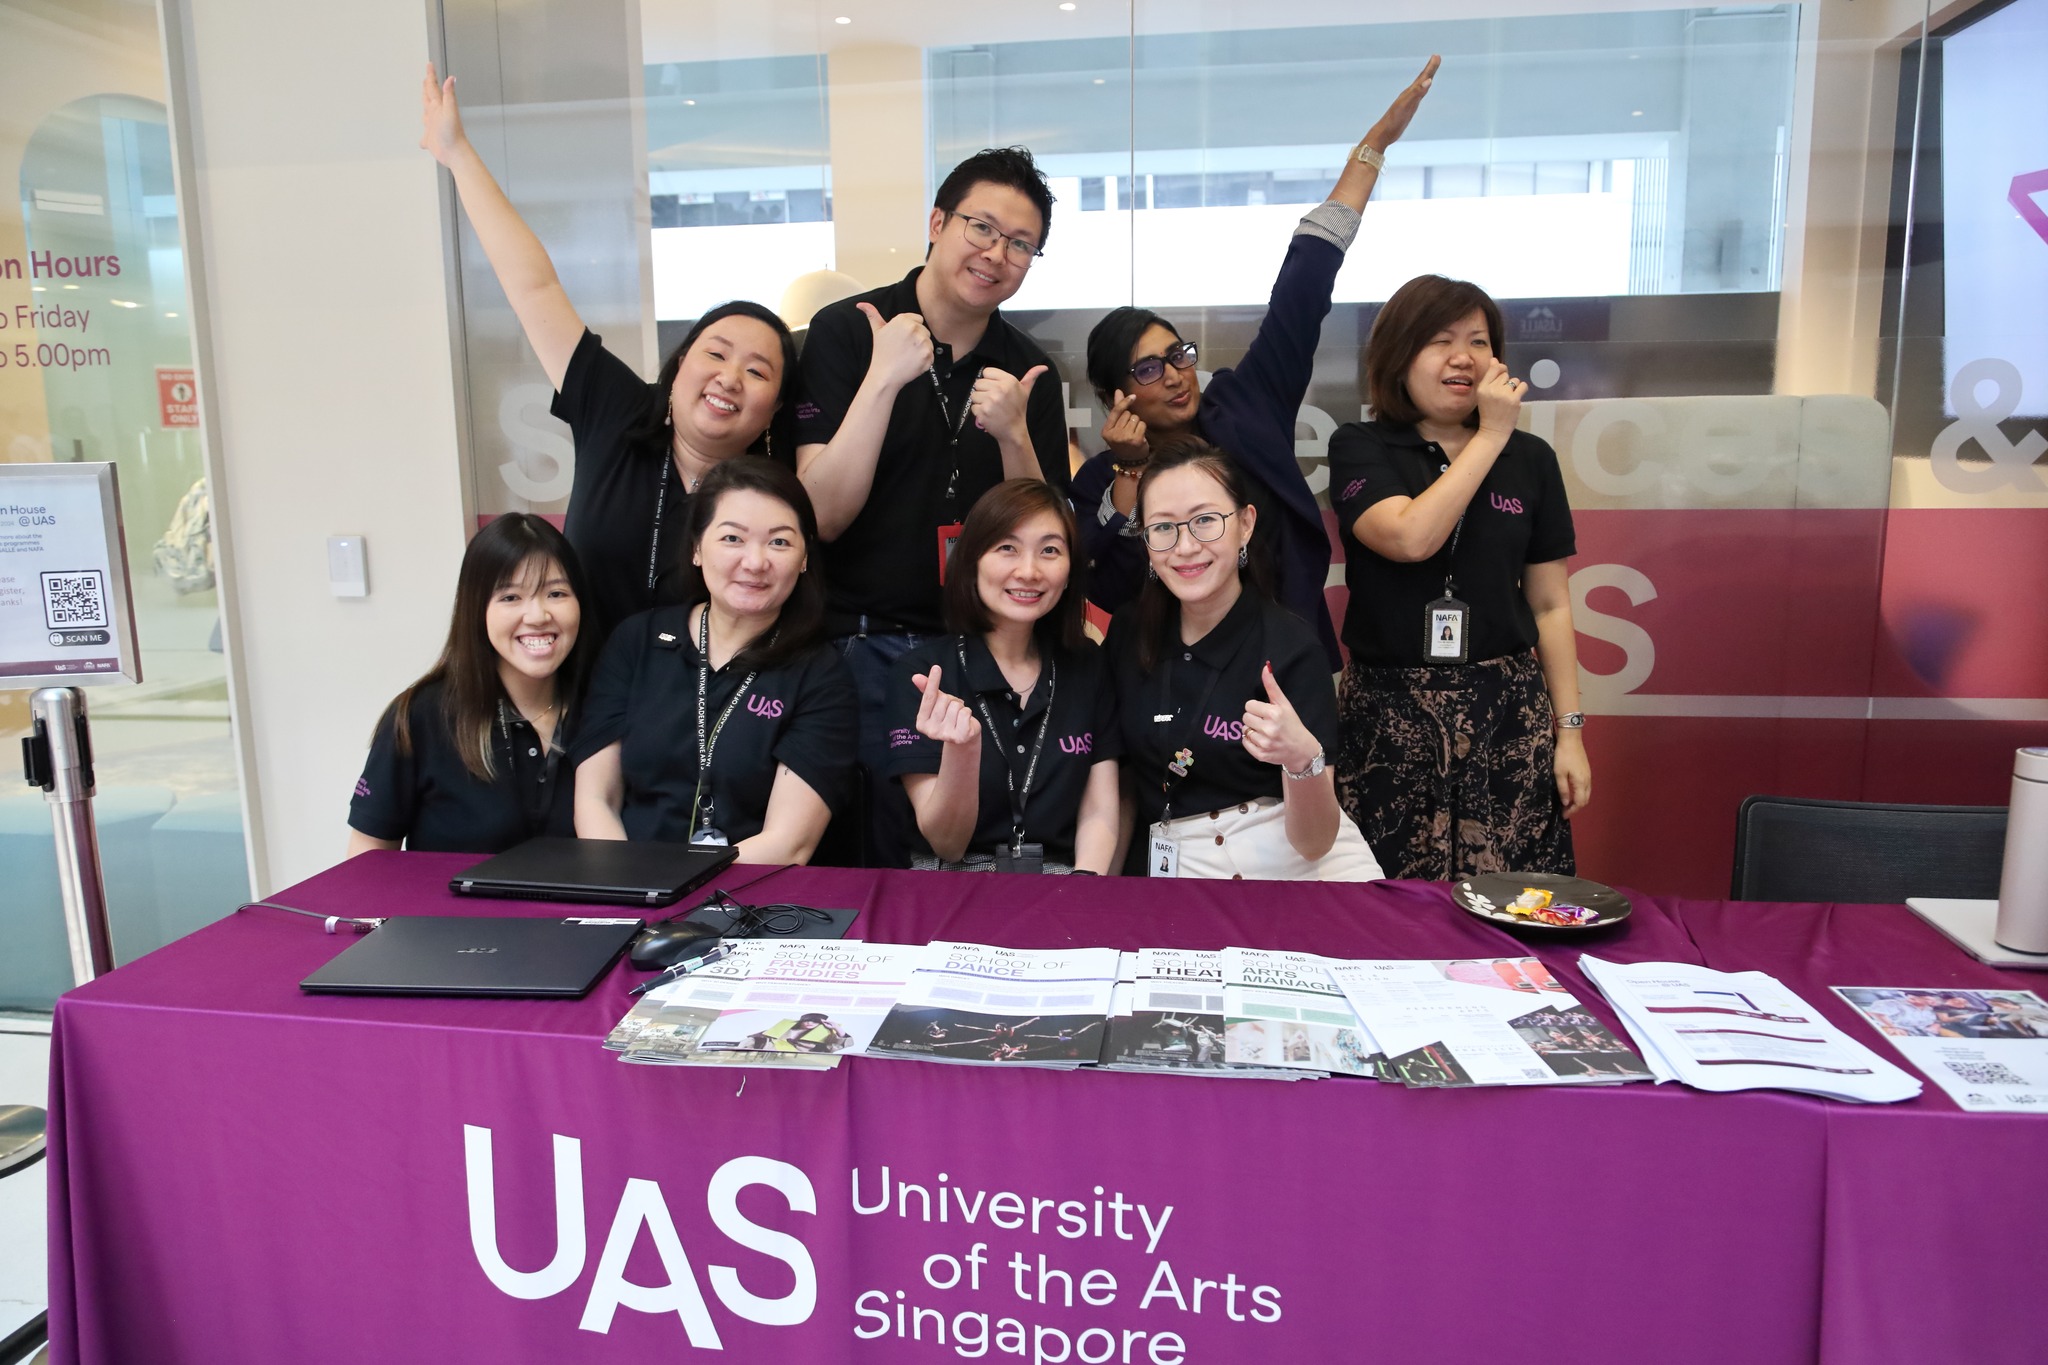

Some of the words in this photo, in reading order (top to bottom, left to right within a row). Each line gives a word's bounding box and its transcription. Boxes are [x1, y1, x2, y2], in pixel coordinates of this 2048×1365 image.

[31, 251, 121, 279] Hours
[15, 304, 90, 332] Friday
[15, 343, 111, 372] 5.00pm
[10, 505, 46, 515] House
[1490, 492, 1524, 514] UAS
[19, 516, 30, 527] @
[32, 515, 56, 526] UAS
[66, 635, 88, 643] SCAN
[699, 667, 707, 695] NANYANG
[747, 694, 784, 719] UAS
[698, 728, 706, 737] OF
[706, 735, 718, 767] NANYANG
[717, 705, 734, 733] ACADEMY
[737, 683, 748, 698] FINE
[1204, 715, 1243, 741] UAS
[1059, 733, 1092, 754] UAS
[1155, 842, 1173, 853] NAFA
[768, 960, 868, 971] FASHION
[774, 952, 858, 963] SCHOOL
[866, 955, 895, 963] OF
[949, 953, 1038, 969] SCHOOL
[1043, 961, 1072, 970] OF
[709, 966, 740, 975] 3D
[763, 968, 860, 979] STUDIES
[945, 961, 1025, 977] DANCE
[1152, 966, 1222, 978] THEAT
[1242, 959, 1325, 975] SCHOOL
[1242, 967, 1298, 979] ARTS
[851, 1166, 1174, 1253] University
[464, 1124, 817, 1350] UAS
[922, 1243, 988, 1290] of
[1008, 1252, 1117, 1307] the
[1139, 1261, 1283, 1323] Arts
[853, 1291, 1186, 1365] Singapore
